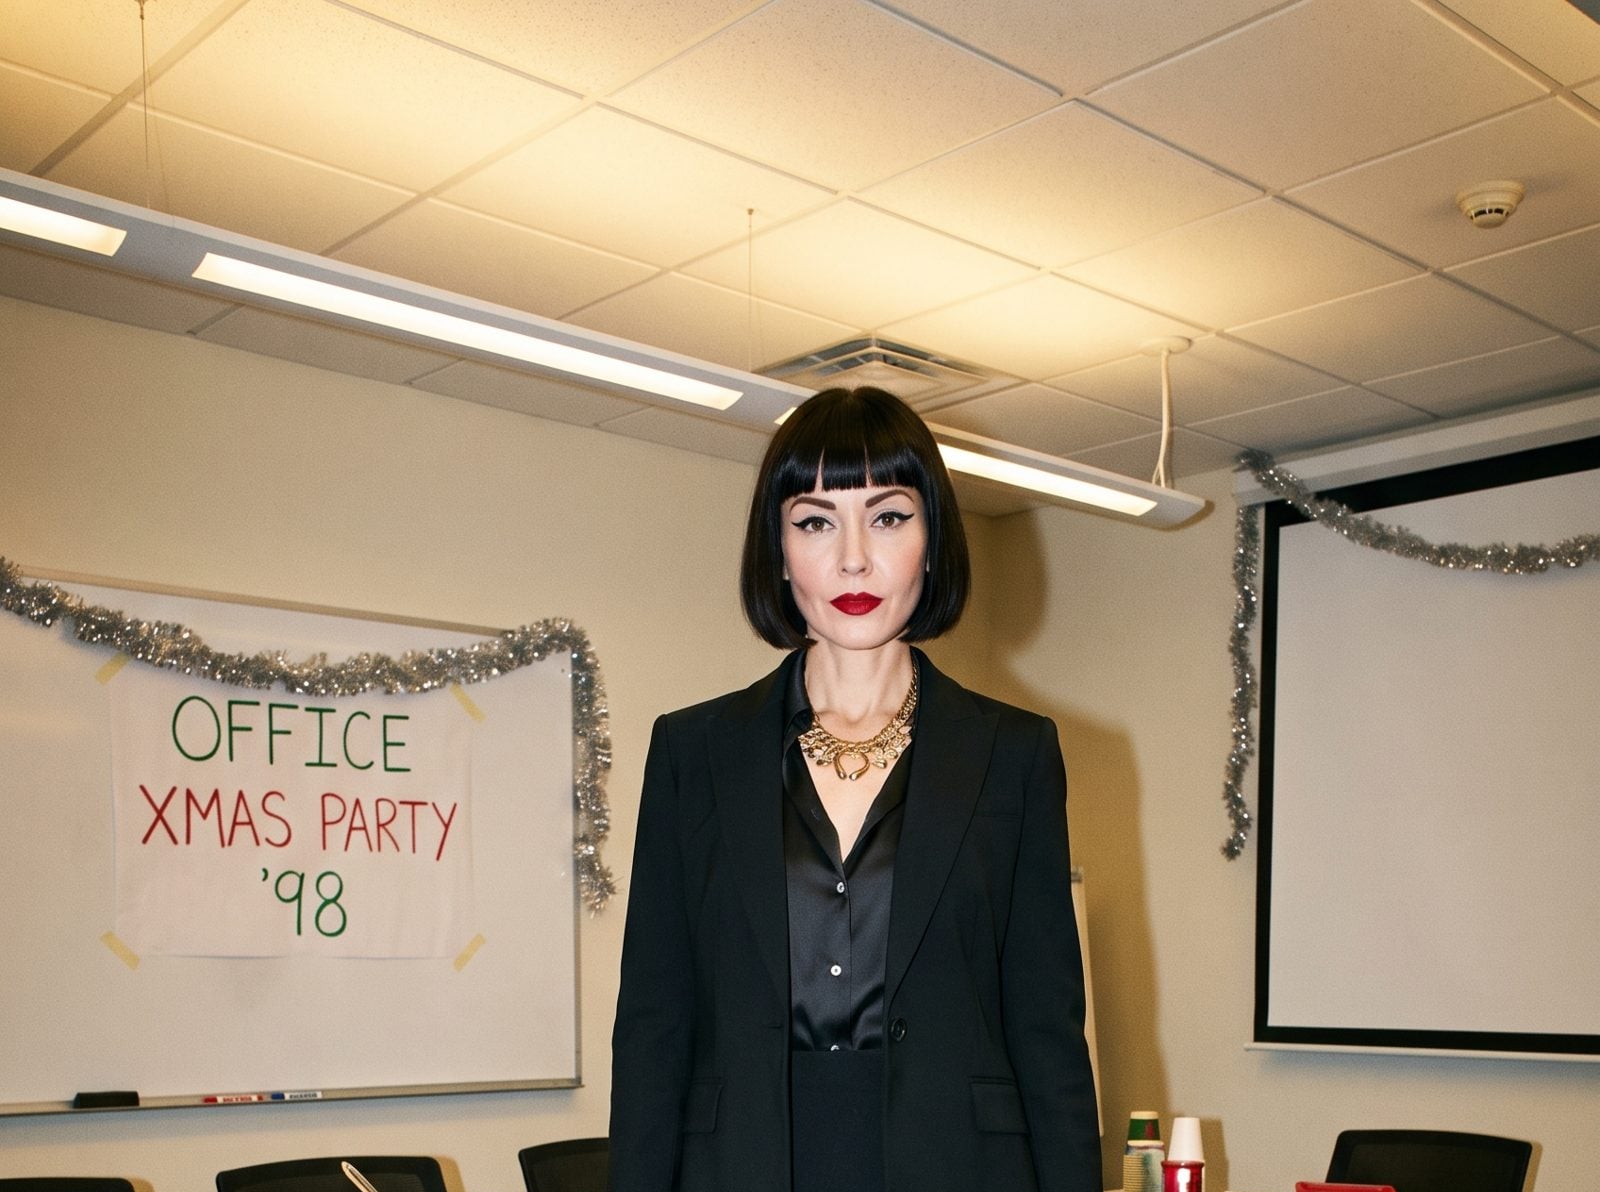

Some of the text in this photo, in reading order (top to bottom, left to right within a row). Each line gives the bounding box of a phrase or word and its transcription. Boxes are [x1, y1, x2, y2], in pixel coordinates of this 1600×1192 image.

[171, 695, 411, 773] OFFICE
[139, 784, 457, 860] XMAS PARTY
[261, 867, 347, 938] '98
